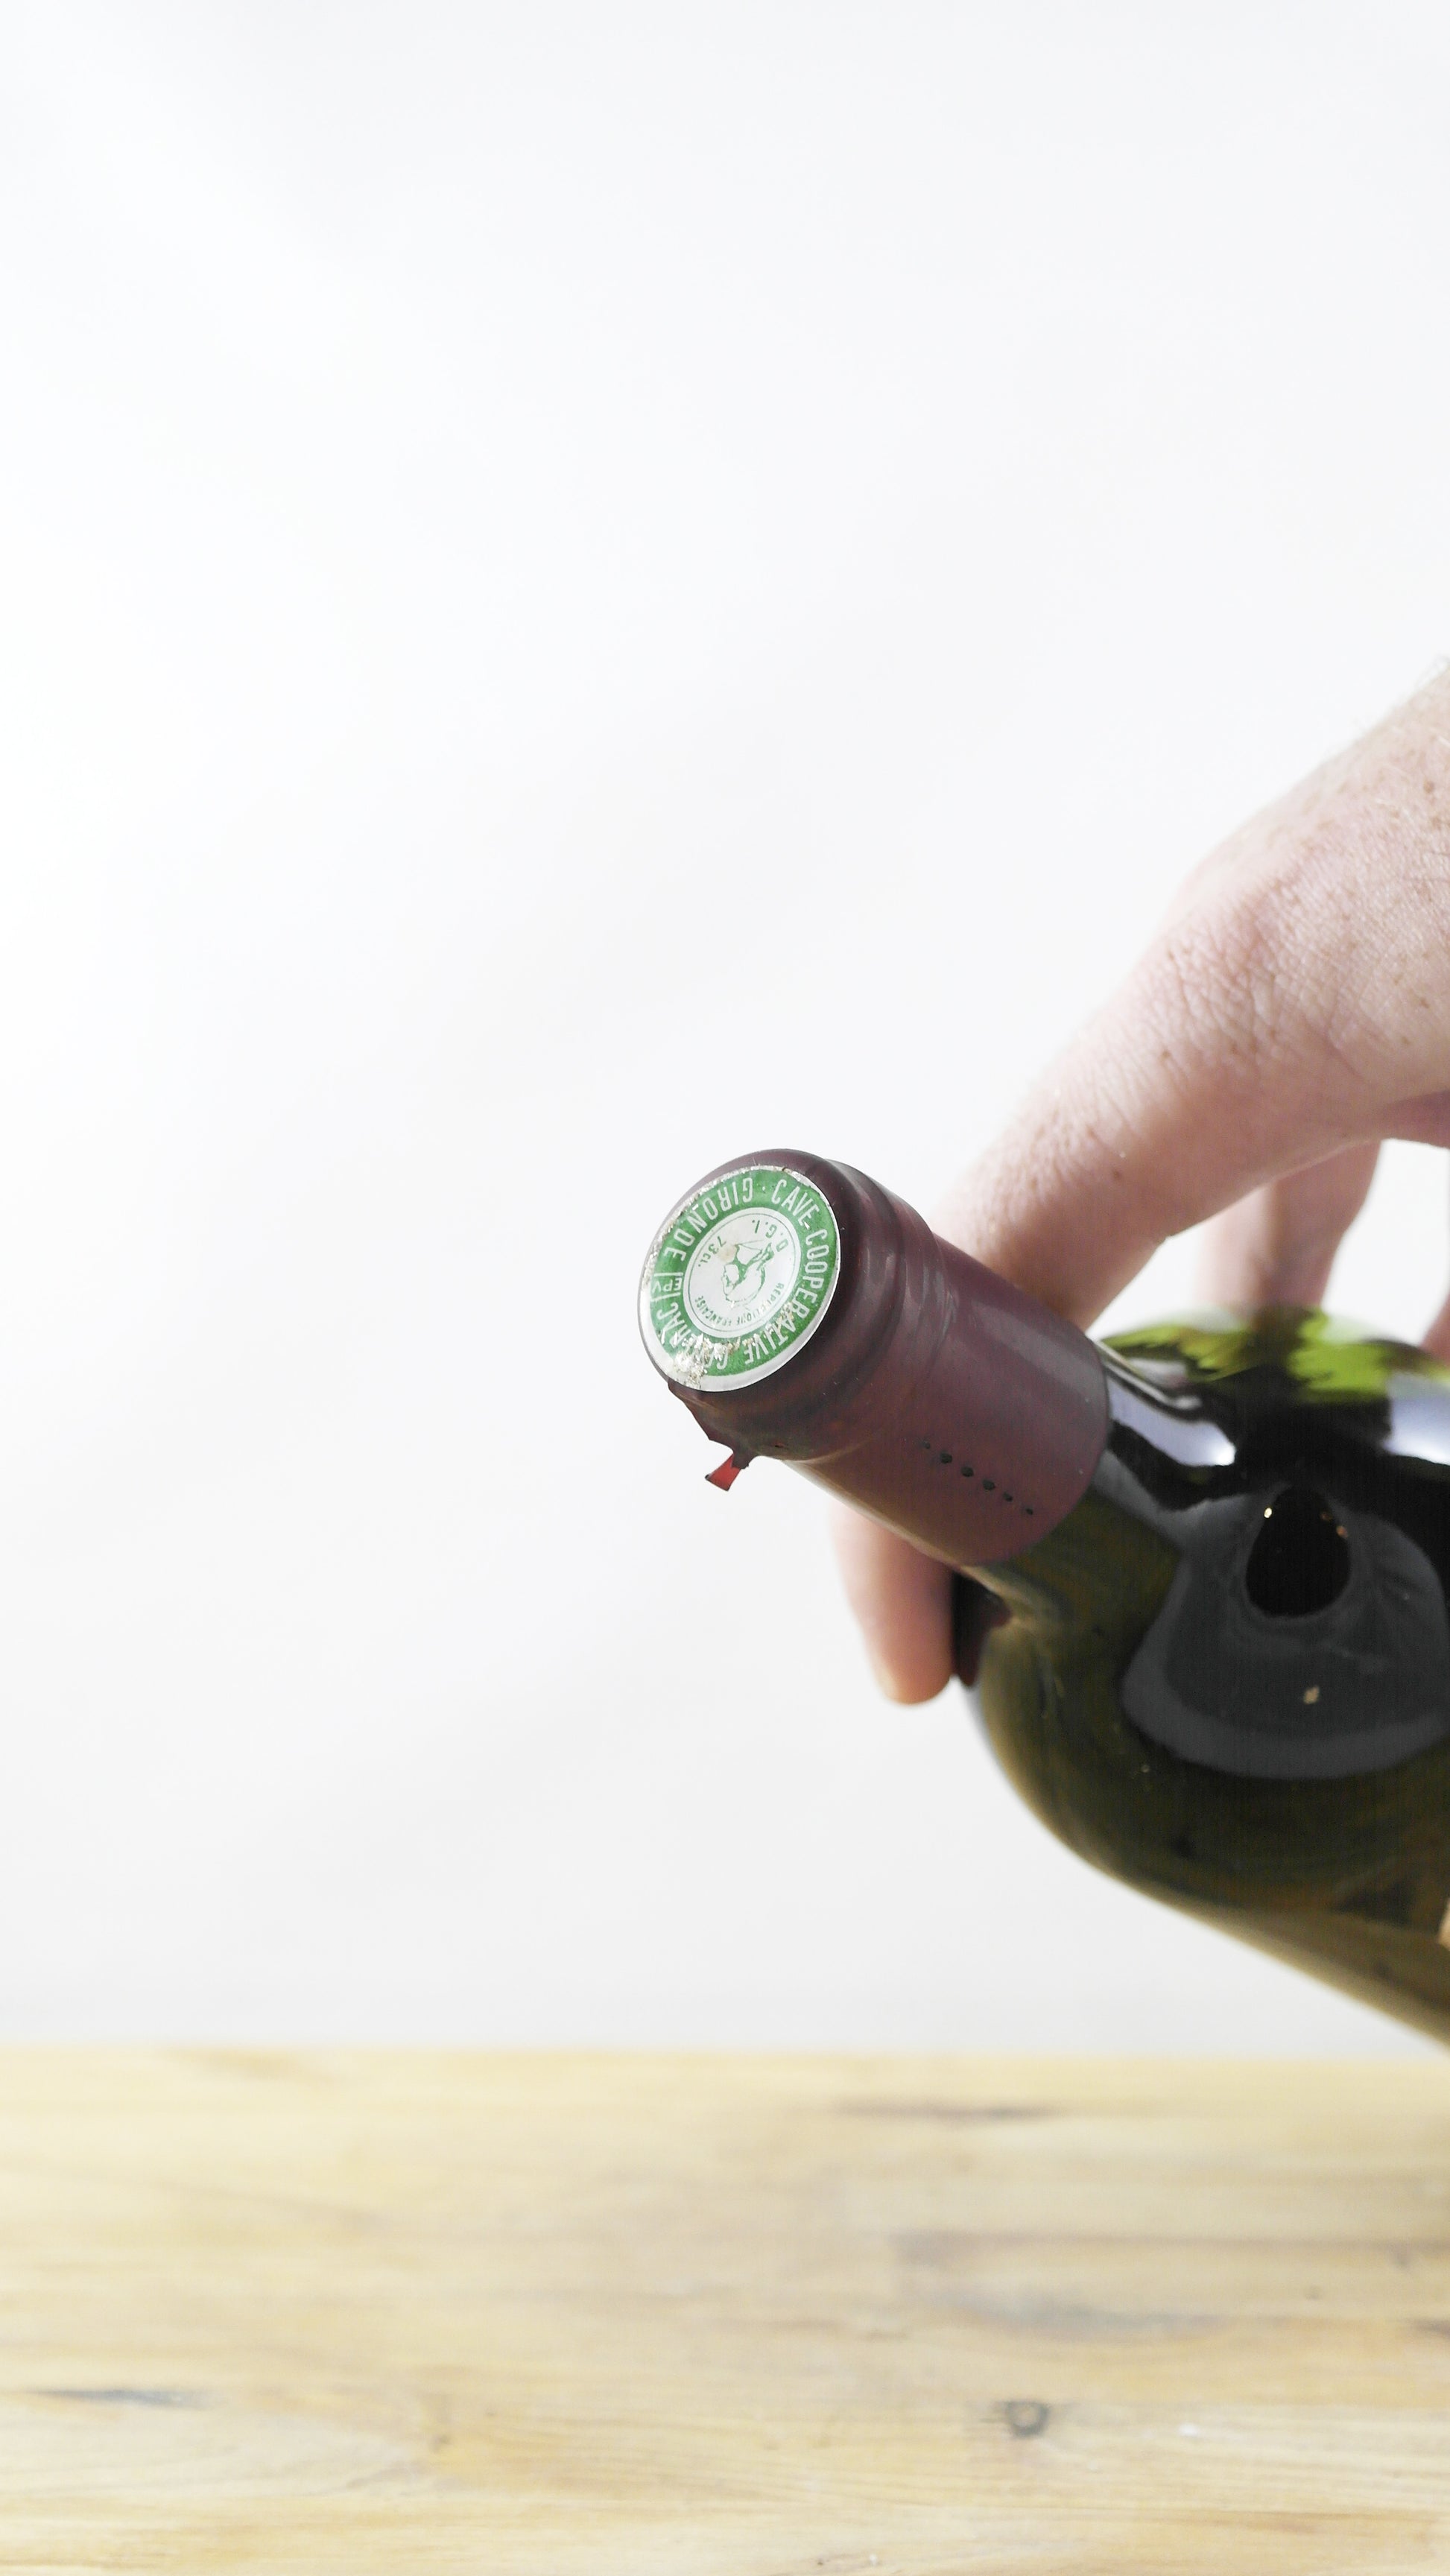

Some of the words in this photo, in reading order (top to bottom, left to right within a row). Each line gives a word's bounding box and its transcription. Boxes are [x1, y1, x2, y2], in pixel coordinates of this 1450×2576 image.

[664, 1177, 753, 1262] GIRONDE
[771, 1179, 820, 1226] CAVE
[736, 1282, 785, 1326] REPLIQUE
[745, 1228, 830, 1365] COOPERATIVE
